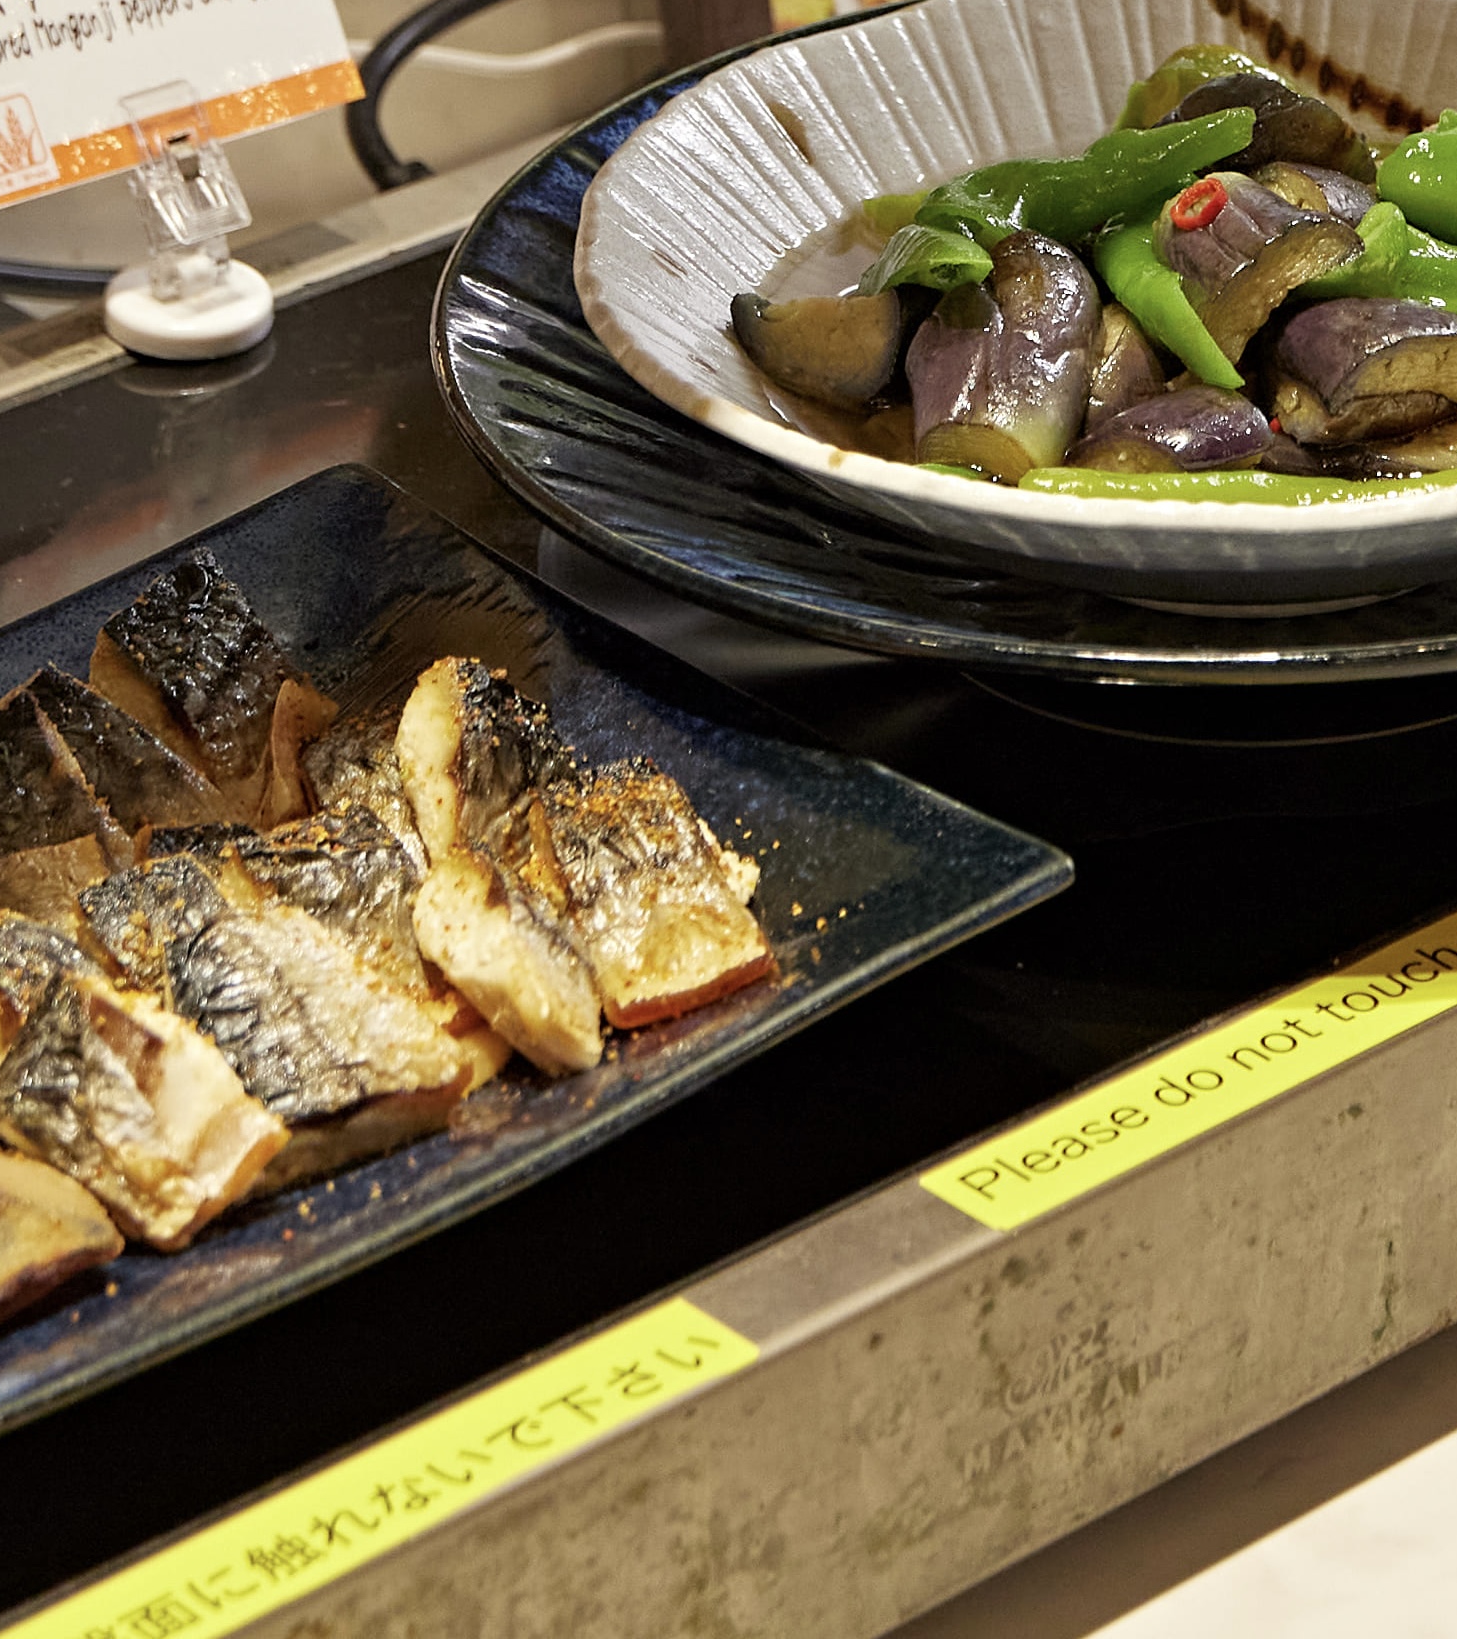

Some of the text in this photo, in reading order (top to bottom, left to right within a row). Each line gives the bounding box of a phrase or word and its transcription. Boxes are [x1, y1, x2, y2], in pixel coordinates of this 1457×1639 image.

[957, 1104, 1150, 1202] Please
[1153, 1067, 1224, 1107] do
[1226, 1018, 1324, 1071] not
[81, 1332, 722, 1639] 面に触れないで下さい
